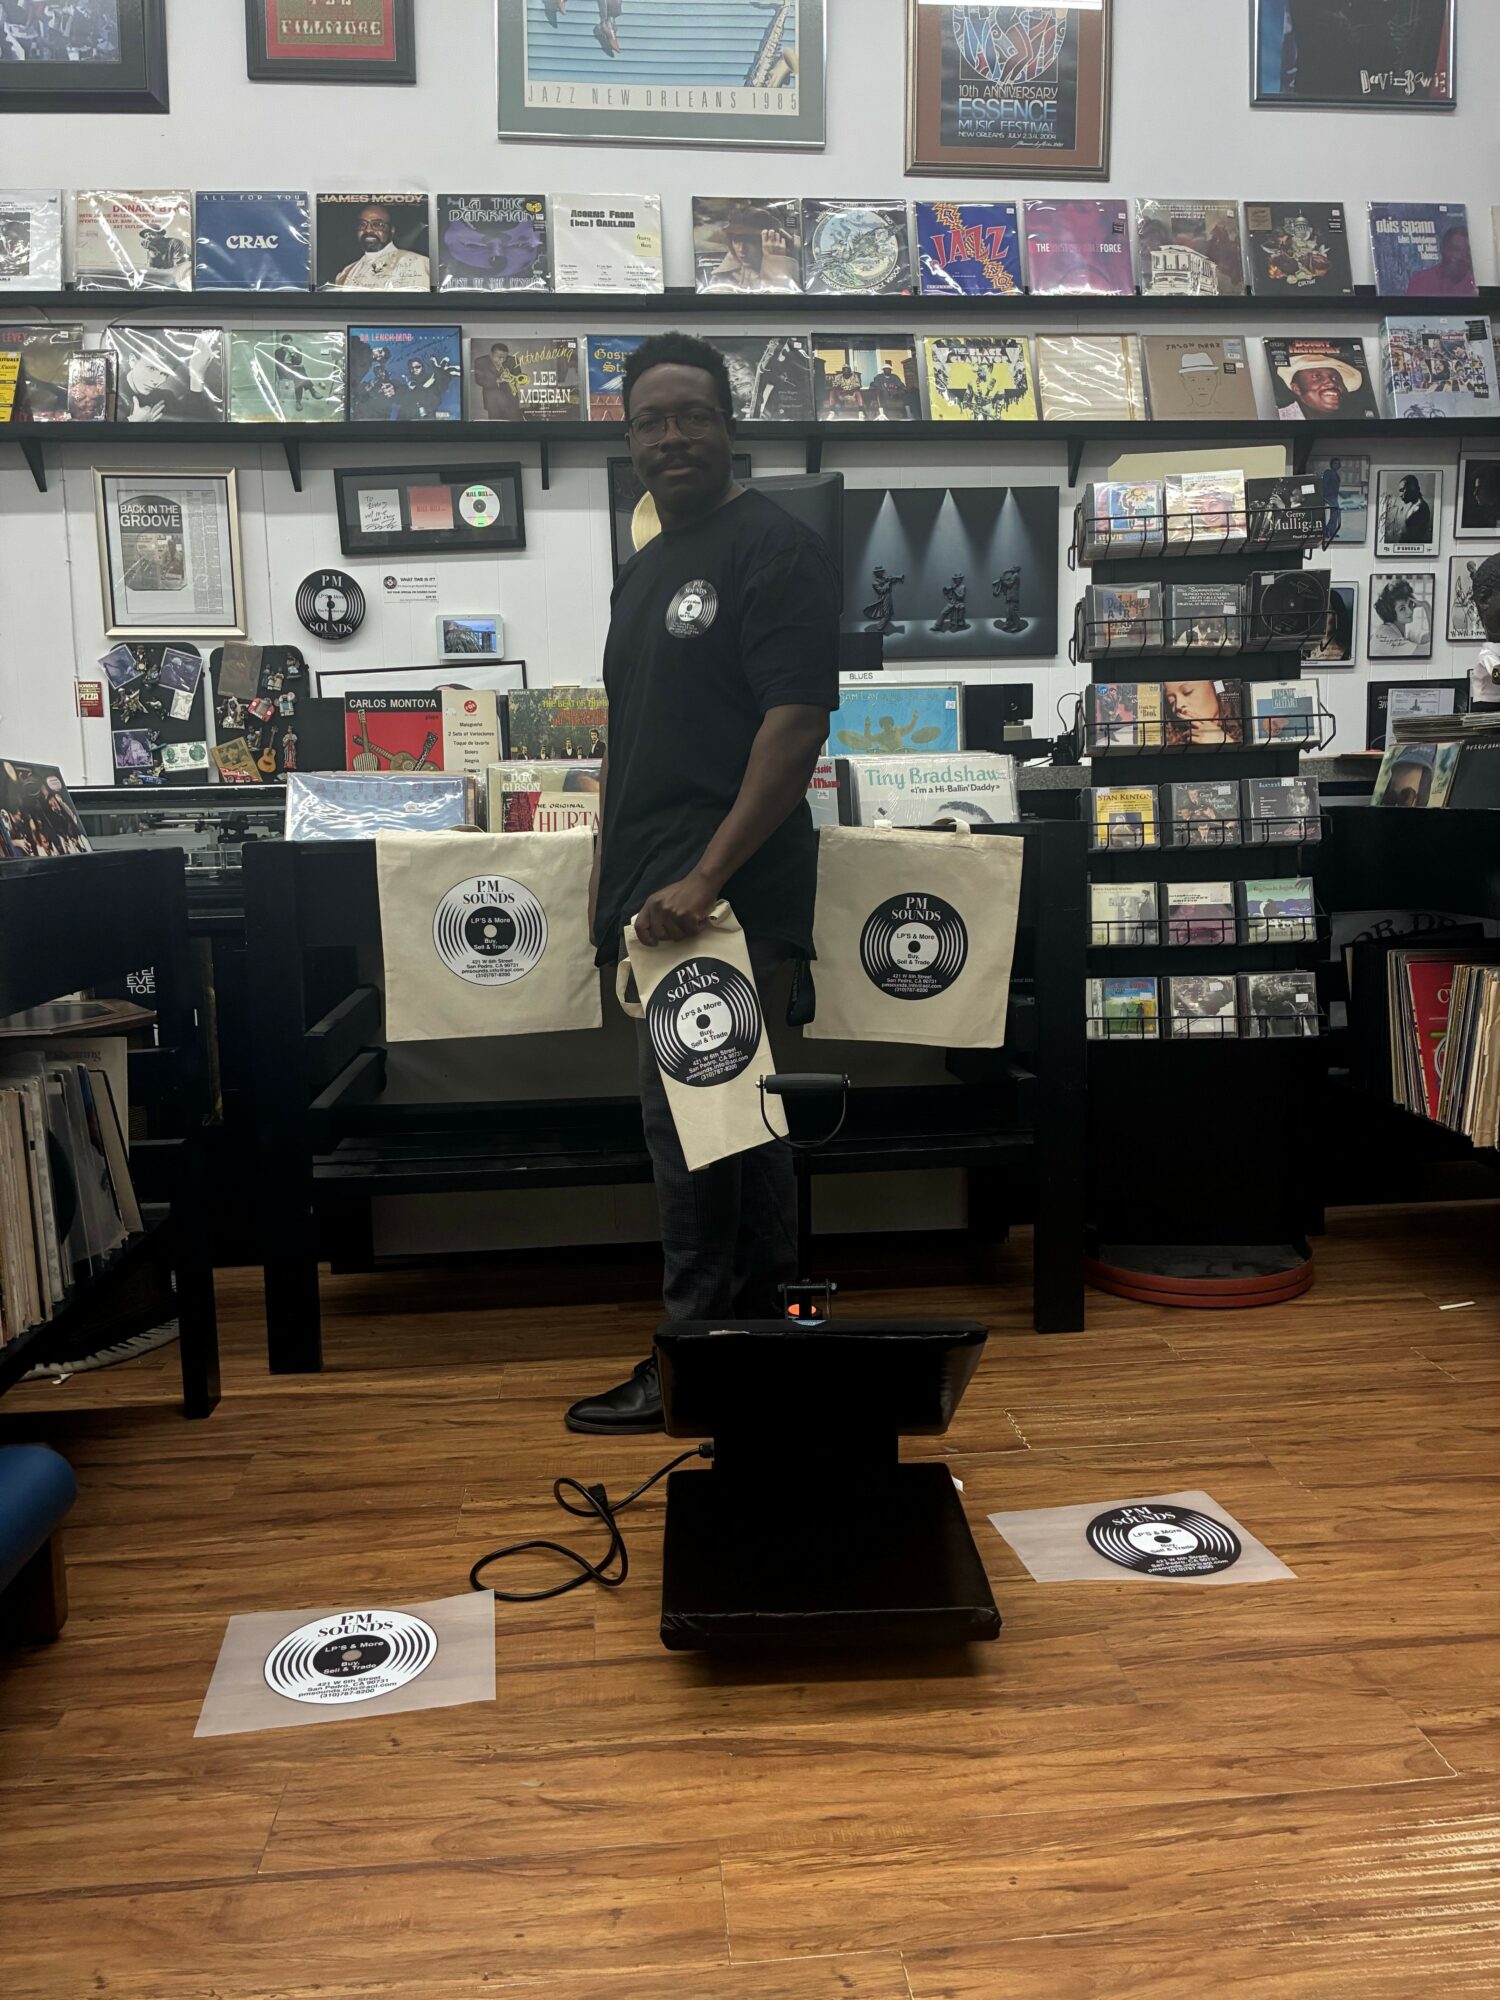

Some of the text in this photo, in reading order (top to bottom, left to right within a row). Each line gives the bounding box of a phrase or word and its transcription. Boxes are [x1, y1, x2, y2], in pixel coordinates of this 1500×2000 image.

[280, 20, 381, 36] FILLMORE
[528, 86, 797, 111] JAZZ NEW ORLEANS 1985
[959, 84, 1058, 100] 10th ANNIVERSARY
[958, 98, 1057, 121] ESSENCE
[959, 120, 1054, 133] MUSIC FESTIVAL
[319, 194, 423, 204] JAMES MOODY
[609, 210, 634, 219] FROM
[596, 219, 635, 228] OAKLAND
[226, 234, 279, 250] CRAC
[930, 224, 1010, 269] JAZZ
[1036, 243, 1122, 253] THE FORCE
[533, 371, 557, 386] LEE
[520, 388, 571, 404] MORGAN
[120, 505, 180, 514] BACK IN THE
[1285, 511, 1305, 519] Gerry
[120, 514, 181, 527] GROOVE
[321, 575, 343, 587] PM
[309, 622, 353, 634] SOUNDS
[849, 672, 873, 680] BLUES
[349, 698, 437, 709] CARLOS MONTOYA
[510, 773, 532, 783] DON
[865, 765, 999, 789] Tiny Bradshaw
[502, 782, 542, 792] GIBSON
[1097, 792, 1152, 801] STAN KENTON
[477, 880, 504, 893] P.M.
[463, 893, 515, 904] SOUNDS
[905, 896, 928, 910] PM
[891, 909, 941, 921] SOUNDS
[676, 962, 701, 985] PM
[666, 971, 720, 1003] SOUNDS
[681, 1001, 722, 1021] LP'S & More
[691, 1039, 703, 1049] Sell
[709, 1031, 728, 1041] Trade
[719, 1047, 737, 1056] Street
[1111, 1511, 1177, 1526] SOUNDS
[1120, 1506, 1153, 1518] PM
[1133, 1530, 1152, 1538] LP'S
[340, 1613, 379, 1626] P.M.
[317, 1620, 394, 1638] SOUNDS
[325, 1644, 348, 1653] LP'S
[359, 1640, 384, 1648] More
[323, 1667, 340, 1675] Sell
[357, 1675, 381, 1683] Street
